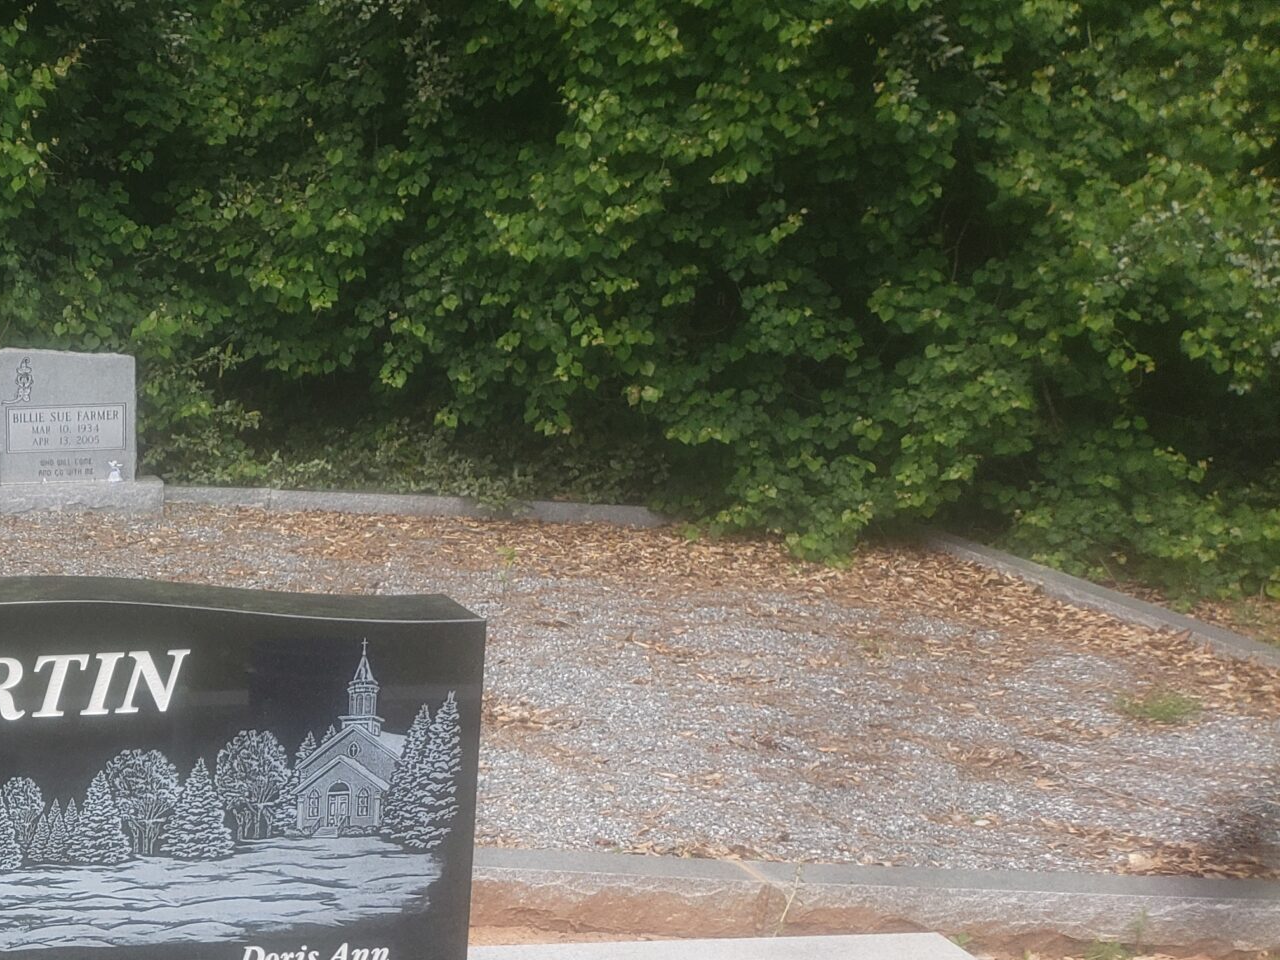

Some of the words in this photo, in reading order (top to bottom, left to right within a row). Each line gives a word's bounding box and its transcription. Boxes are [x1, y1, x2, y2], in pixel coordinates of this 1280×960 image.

[13, 412, 45, 424] BILLIE
[50, 411, 72, 422] SUE
[77, 409, 119, 421] FARMER
[77, 423, 100, 433] 1934
[76, 435, 100, 445] 2005
